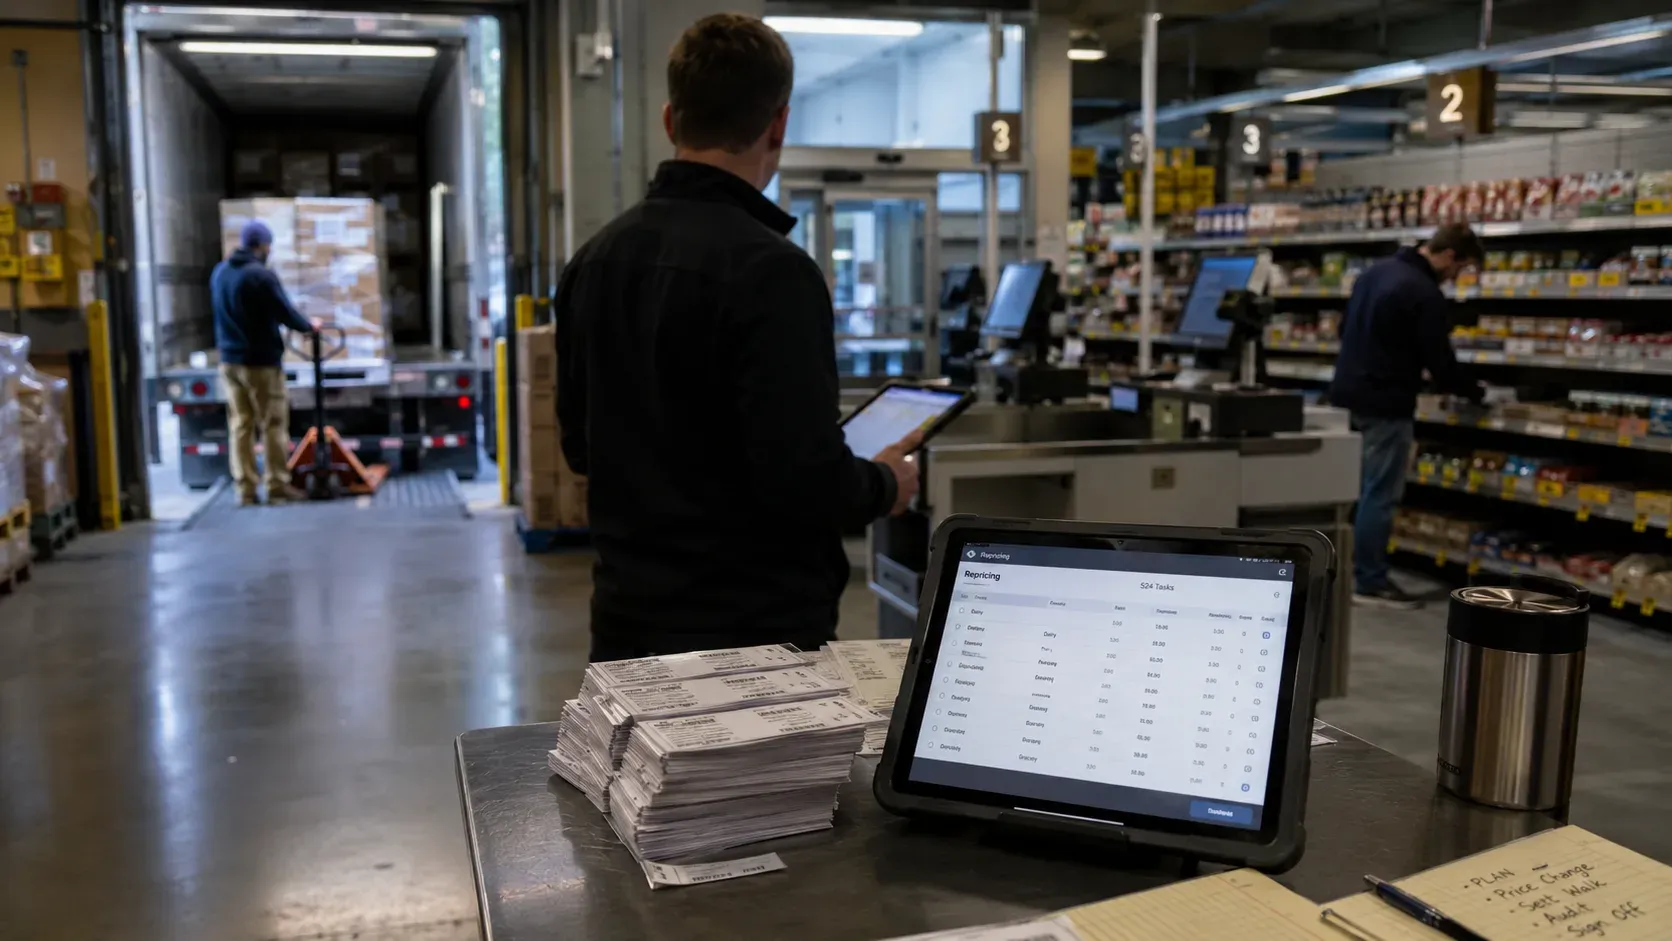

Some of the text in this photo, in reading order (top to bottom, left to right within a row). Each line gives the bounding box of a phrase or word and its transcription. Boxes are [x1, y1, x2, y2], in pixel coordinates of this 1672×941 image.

[1440, 84, 1463, 122] 2
[1242, 124, 1260, 155] 3
[964, 570, 1001, 581] Repricing
[1155, 583, 1174, 591] Tasks
[1470, 868, 1515, 888] PLAN
[1493, 864, 1595, 900] Price Change
[1561, 880, 1607, 897] Walk
